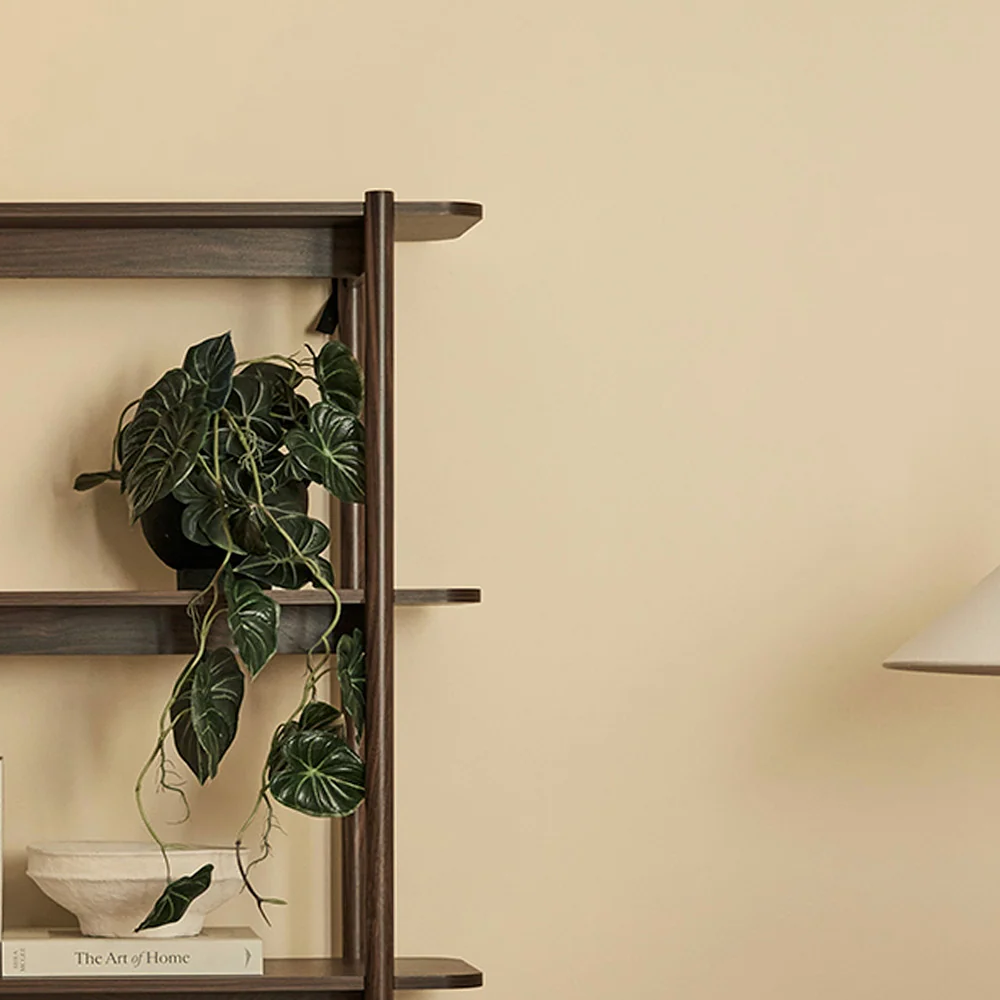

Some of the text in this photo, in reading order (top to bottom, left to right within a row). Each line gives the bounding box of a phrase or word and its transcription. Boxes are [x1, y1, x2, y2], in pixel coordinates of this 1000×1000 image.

[74, 950, 191, 968] The Art of Home
